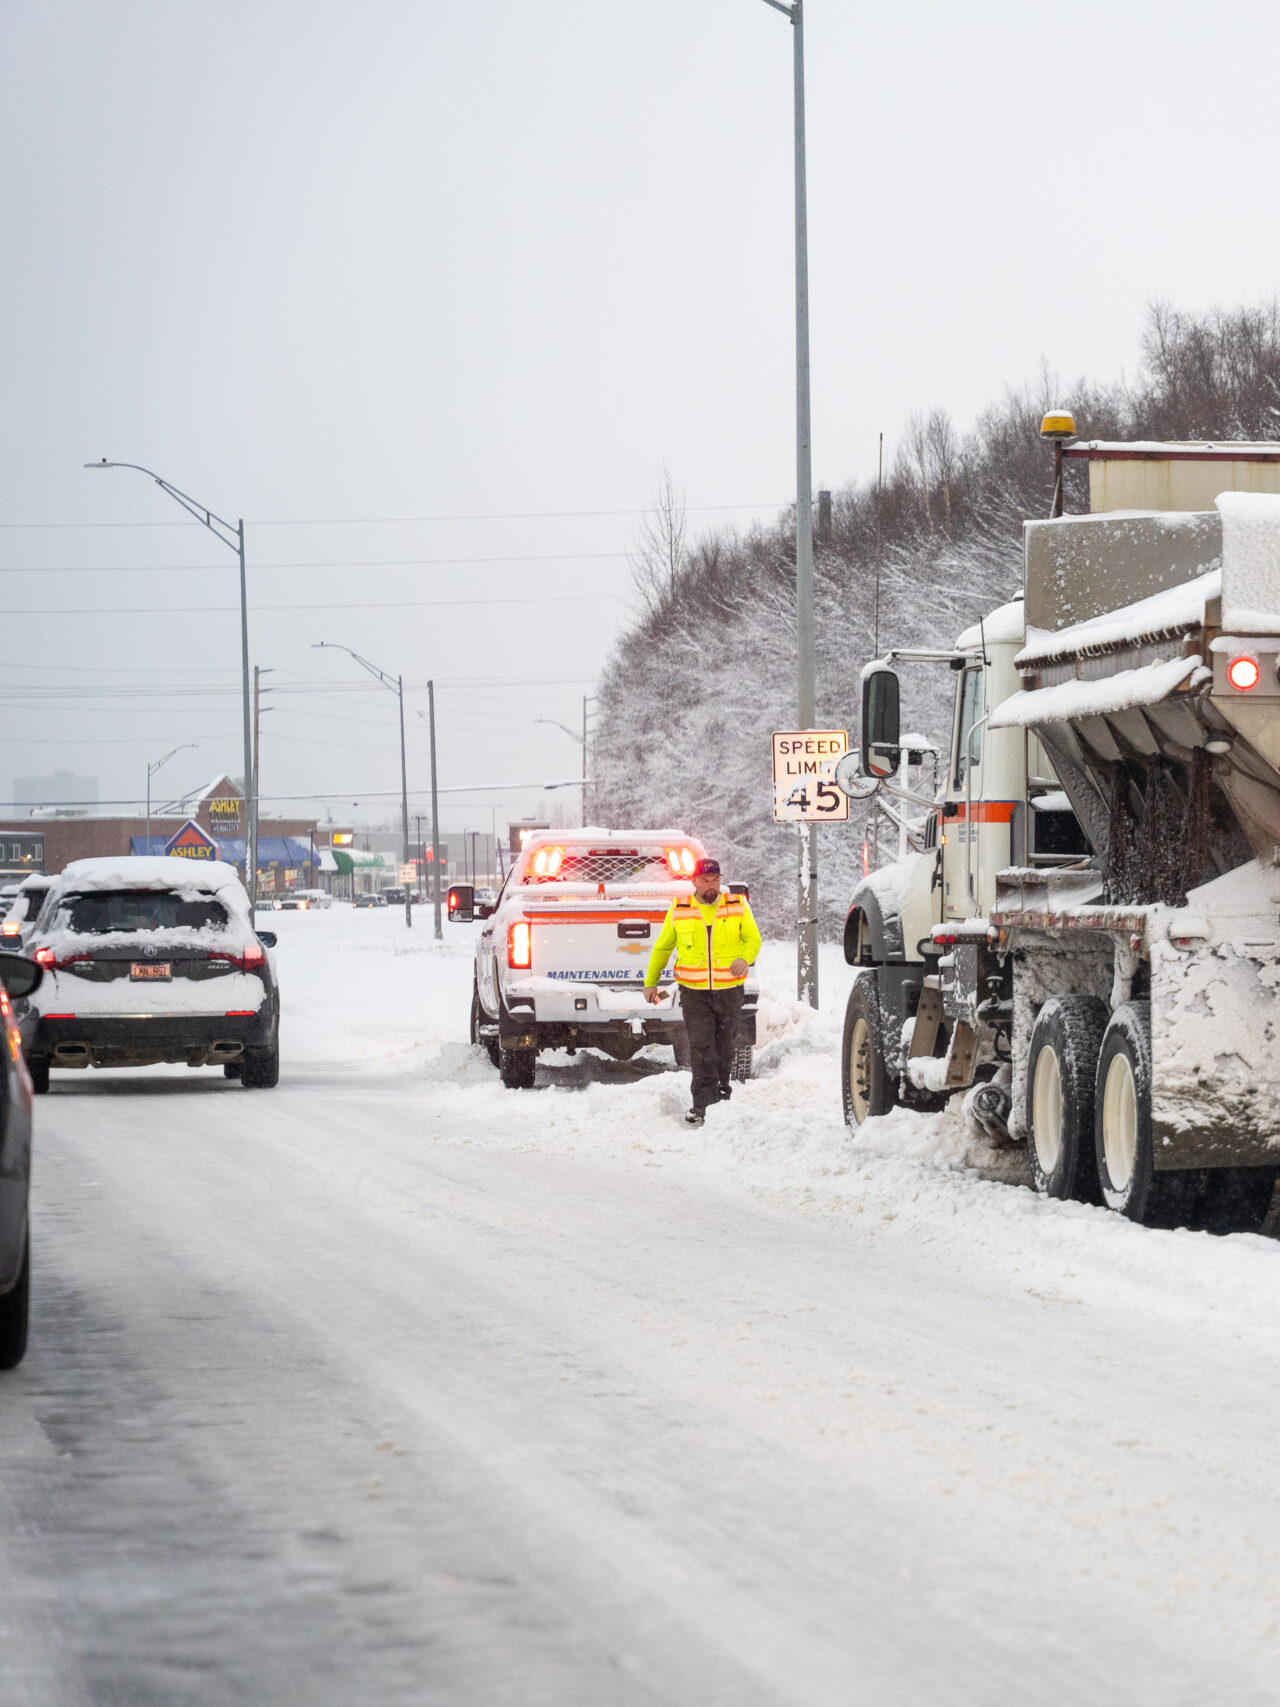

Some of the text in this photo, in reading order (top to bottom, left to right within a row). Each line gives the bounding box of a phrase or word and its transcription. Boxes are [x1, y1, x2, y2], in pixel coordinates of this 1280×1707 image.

[779, 741, 840, 754] SPEED
[786, 761, 832, 775] LIMI
[785, 781, 841, 812] 45
[210, 800, 239, 813] ASHLEY
[169, 847, 212, 857] ASHLEY
[547, 970, 644, 979] MAINTENANCE &
